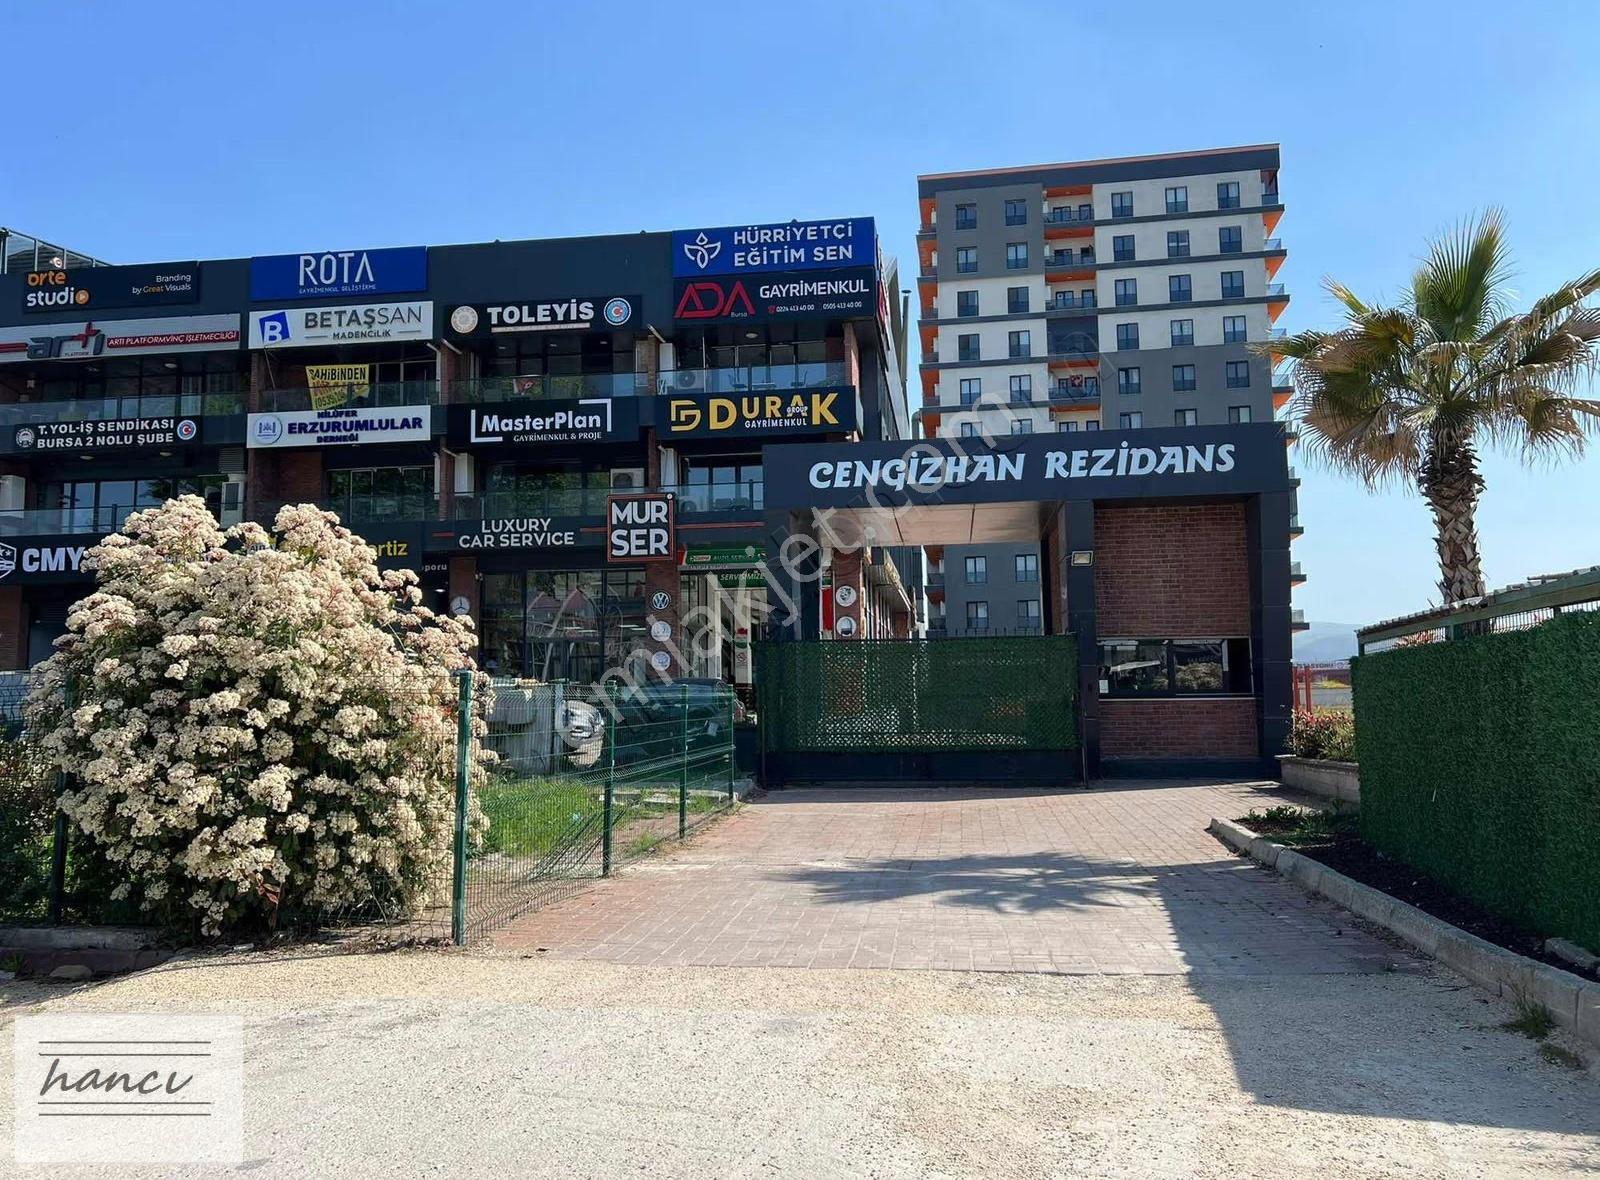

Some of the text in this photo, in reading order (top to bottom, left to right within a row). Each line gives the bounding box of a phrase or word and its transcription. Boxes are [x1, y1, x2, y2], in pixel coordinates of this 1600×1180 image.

[734, 221, 852, 245] HÜRRİYETÇİ
[734, 244, 852, 267] EĞİTİM SEN
[156, 273, 191, 283] Branding
[299, 252, 374, 286] ROTA
[26, 287, 90, 307] studio
[132, 282, 191, 294] by Great Visuals
[759, 279, 869, 299] GAYRİMENKUL
[674, 280, 756, 319] ADA
[304, 305, 422, 329] BETAŞSAN
[487, 299, 594, 325] TOLEYİS
[709, 393, 839, 430] DURAK
[786, 405, 808, 414] GROUP
[97, 418, 174, 433] SENDİKASI
[287, 417, 423, 434] ERZURUMLULAR
[481, 411, 601, 433] MasterPlan
[745, 416, 807, 428] GAYRİMENKUL
[37, 437, 83, 449] BURSA
[85, 437, 93, 446] 2
[96, 435, 133, 446] NOLU
[137, 432, 174, 446] ŞUBE
[513, 431, 602, 442] GAYRİMENKUL & PROJE
[809, 440, 1235, 490] CENGİZHAN REZİDANS
[611, 500, 668, 525] MUR
[481, 517, 551, 534] LUXURY
[459, 531, 575, 548] CAR SERVICE
[611, 528, 669, 557] SER
